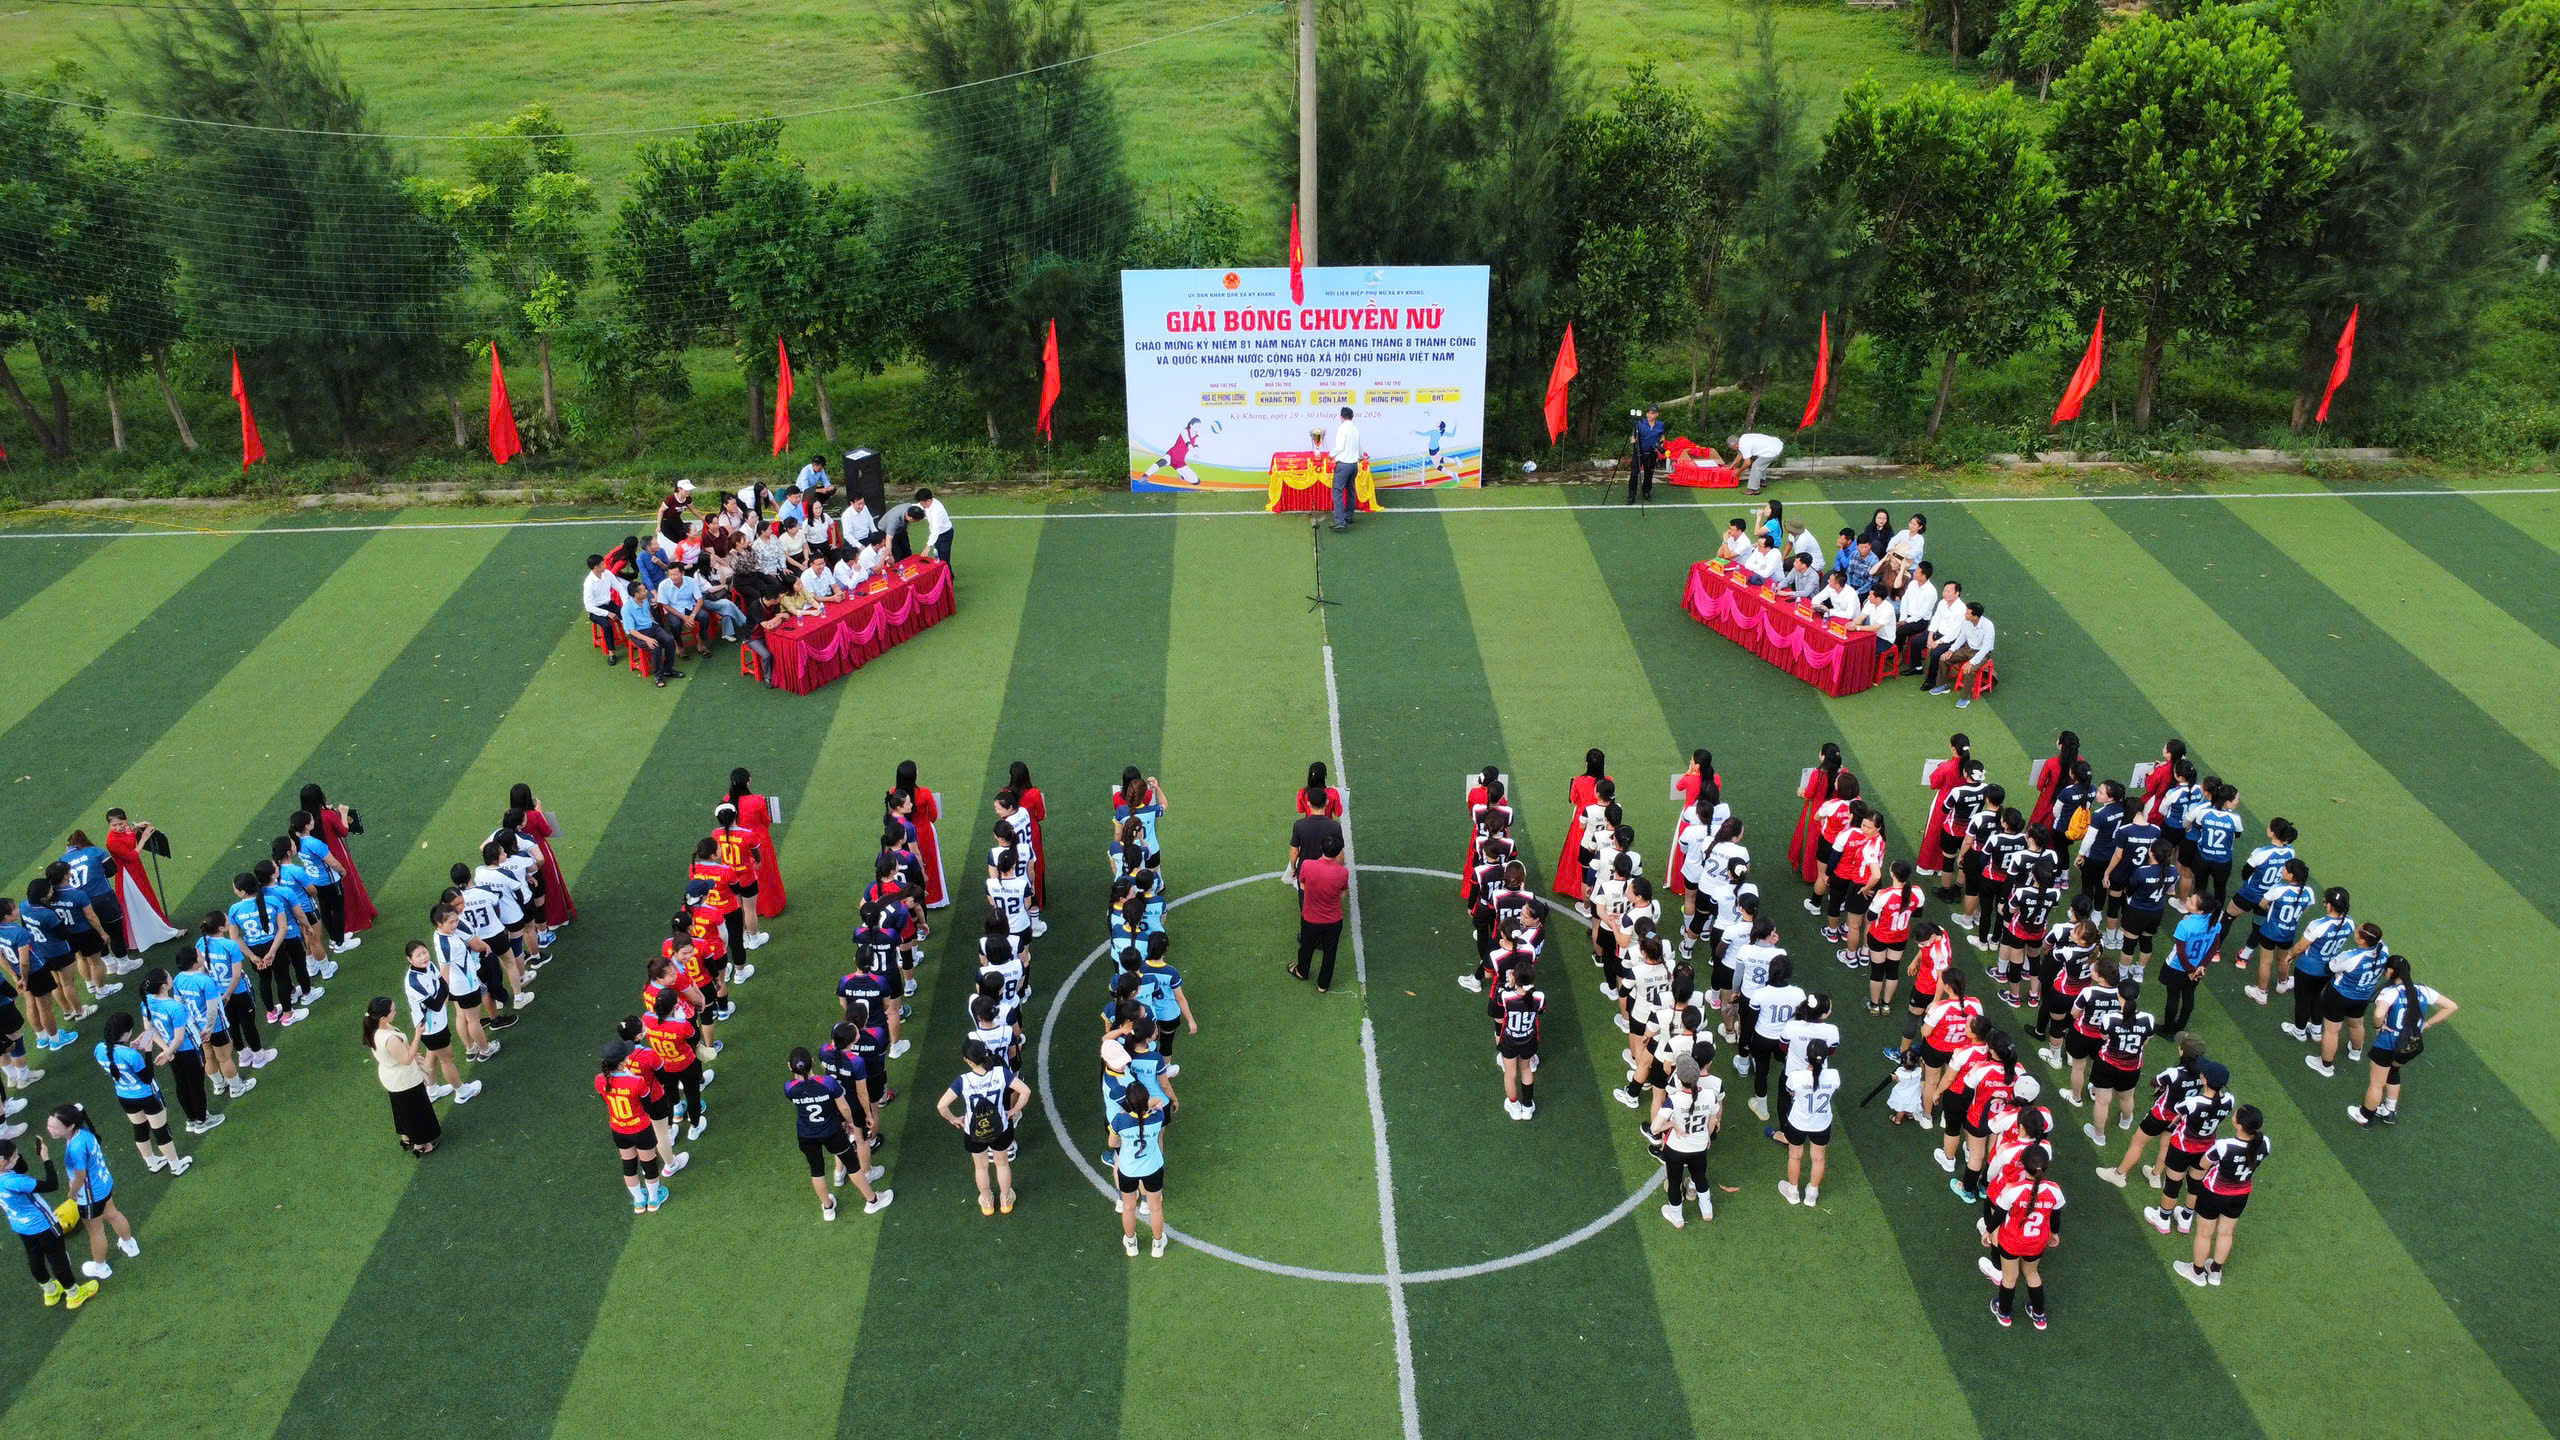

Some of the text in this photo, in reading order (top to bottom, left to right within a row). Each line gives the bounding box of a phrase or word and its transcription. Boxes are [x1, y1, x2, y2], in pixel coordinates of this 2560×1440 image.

[1166, 299, 1445, 332] GIẢI BÓNG CHUYỀN NỮ
[1135, 339, 1161, 351] CHÀO
[1164, 338, 1193, 350] MỪNG
[1212, 338, 1237, 351] NIỆM
[1240, 340, 1251, 349] 81
[1255, 337, 1278, 348] NĂM
[1281, 337, 1306, 348] NGÀY
[1310, 337, 1336, 348] CÁCH
[1339, 337, 1368, 350] MẠNG
[1371, 336, 1403, 347] THÁNG
[1406, 338, 1412, 347] 8
[1415, 336, 1447, 347] THÀNH
[1449, 336, 1476, 347] CÔNG
[1156, 350, 1455, 365] VÀ QUỐC KHÁNH NƯỚC CỘNG HÒA XÃ HỘI CHỦ NGHĨA VIỆT NAM
[1250, 368, 1301, 379] (02/9/1945
[1310, 367, 1362, 377] 02/9/2026)
[1284, 396, 1296, 404] THỌ
[1968, 803, 1980, 819] 7
[2207, 828, 2227, 848] 12
[2132, 846, 2148, 865] 3
[2149, 885, 2165, 903] 4
[1890, 909, 1912, 931] 10
[2319, 938, 2347, 956] 08
[1752, 966, 1767, 984] 8
[1508, 1011, 1536, 1031] 09
[1768, 1004, 1793, 1023] 10
[1944, 1023, 1967, 1043] 12
[2133, 1025, 2146, 1033] Thọ
[650, 1036, 680, 1059] 08
[2118, 1034, 2141, 1054] 12
[607, 1095, 633, 1120] 10
[1804, 1092, 1831, 1114] 12
[806, 1104, 825, 1122] 2
[1684, 1114, 1706, 1134] 12
[2198, 1118, 2220, 1136] 9
[1133, 1139, 1147, 1159] 2
[2235, 1164, 2252, 1181] 4
[2023, 1211, 2044, 1237] 2
